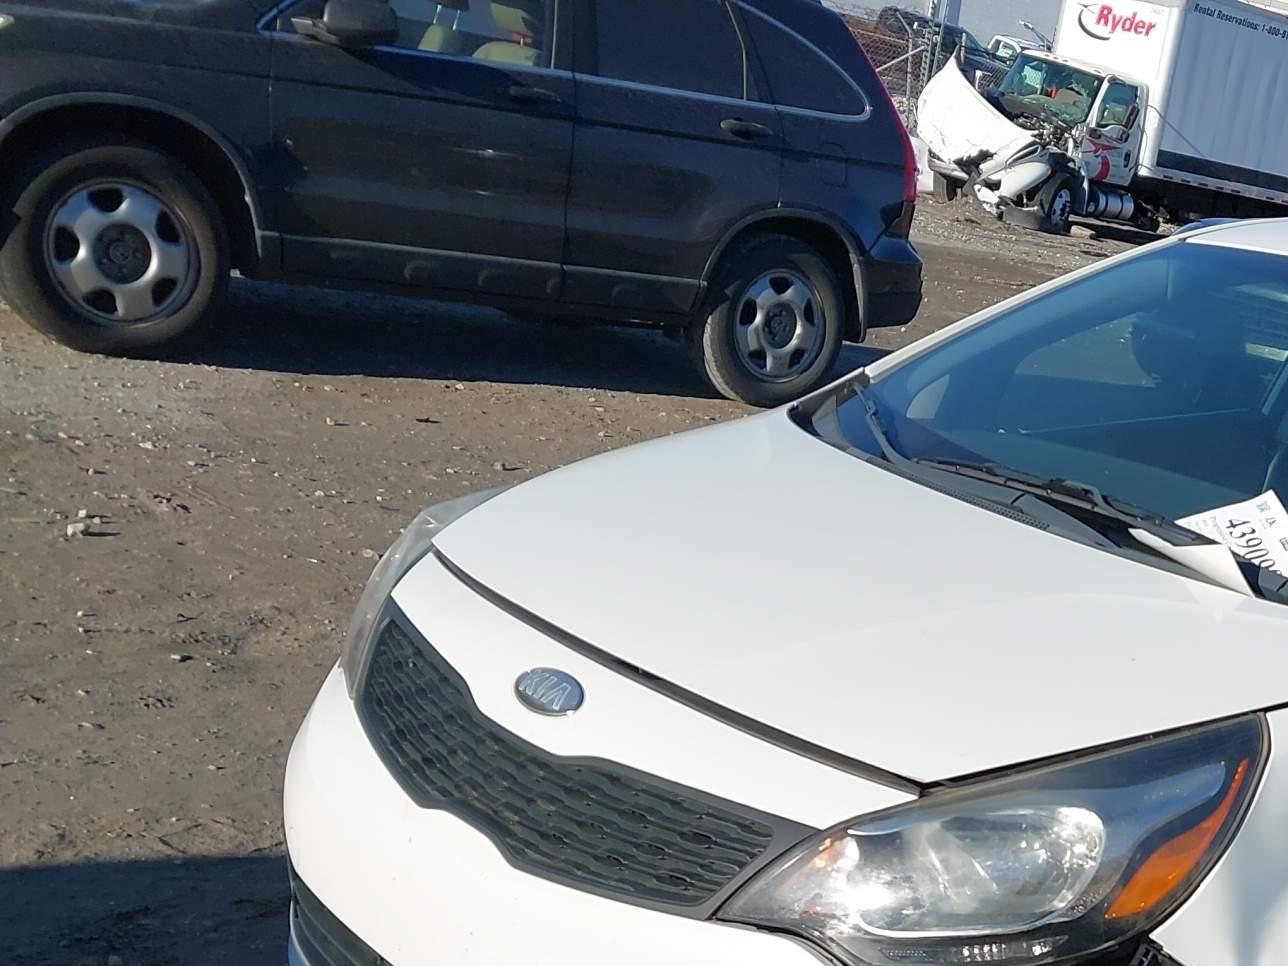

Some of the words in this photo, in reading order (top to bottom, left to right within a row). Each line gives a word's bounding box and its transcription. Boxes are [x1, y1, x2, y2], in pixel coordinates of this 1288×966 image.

[1095, 4, 1157, 36] Ryder
[1194, 3, 1217, 17] Rental
[1216, 9, 1261, 31] Reservations:
[518, 671, 572, 711] KIA
